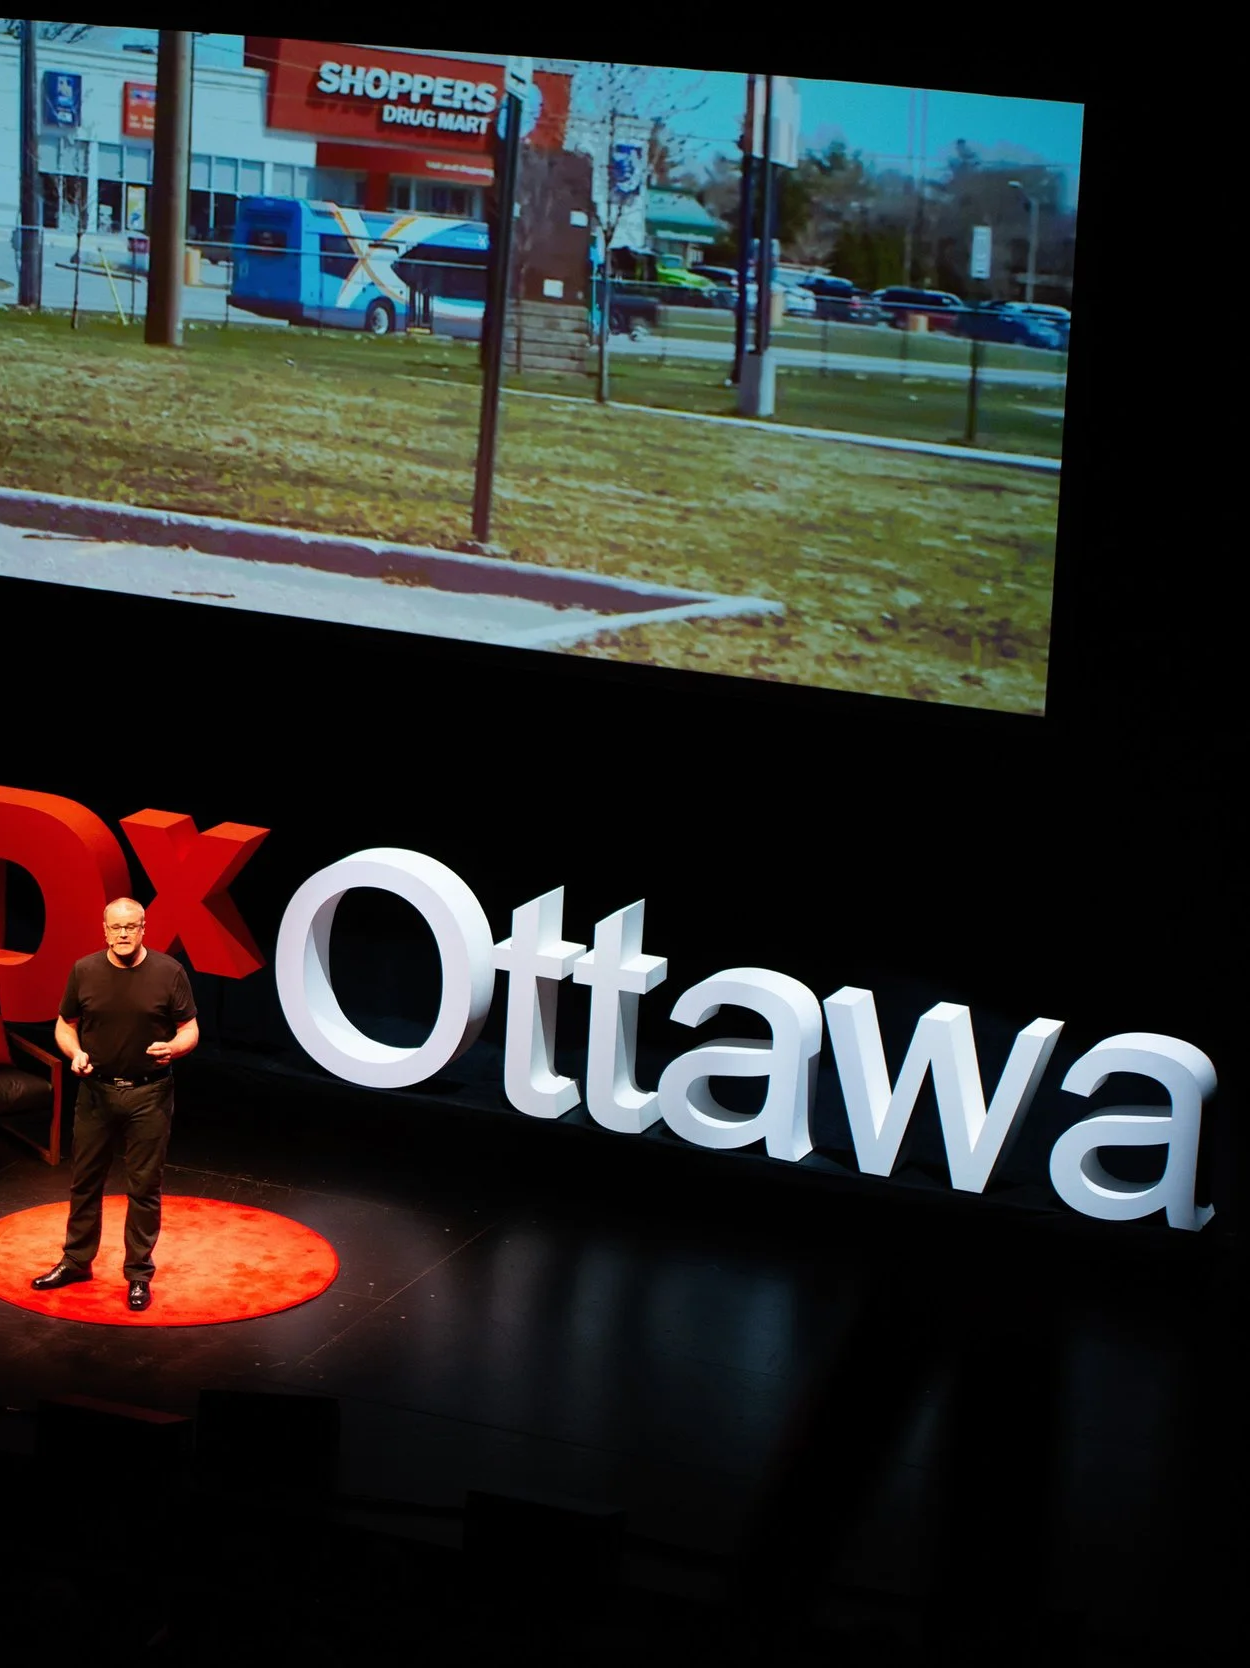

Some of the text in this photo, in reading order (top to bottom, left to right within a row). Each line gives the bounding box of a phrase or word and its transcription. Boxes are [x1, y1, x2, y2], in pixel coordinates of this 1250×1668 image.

[317, 61, 498, 113] SHOPPERS
[383, 105, 491, 135] DRUG MART
